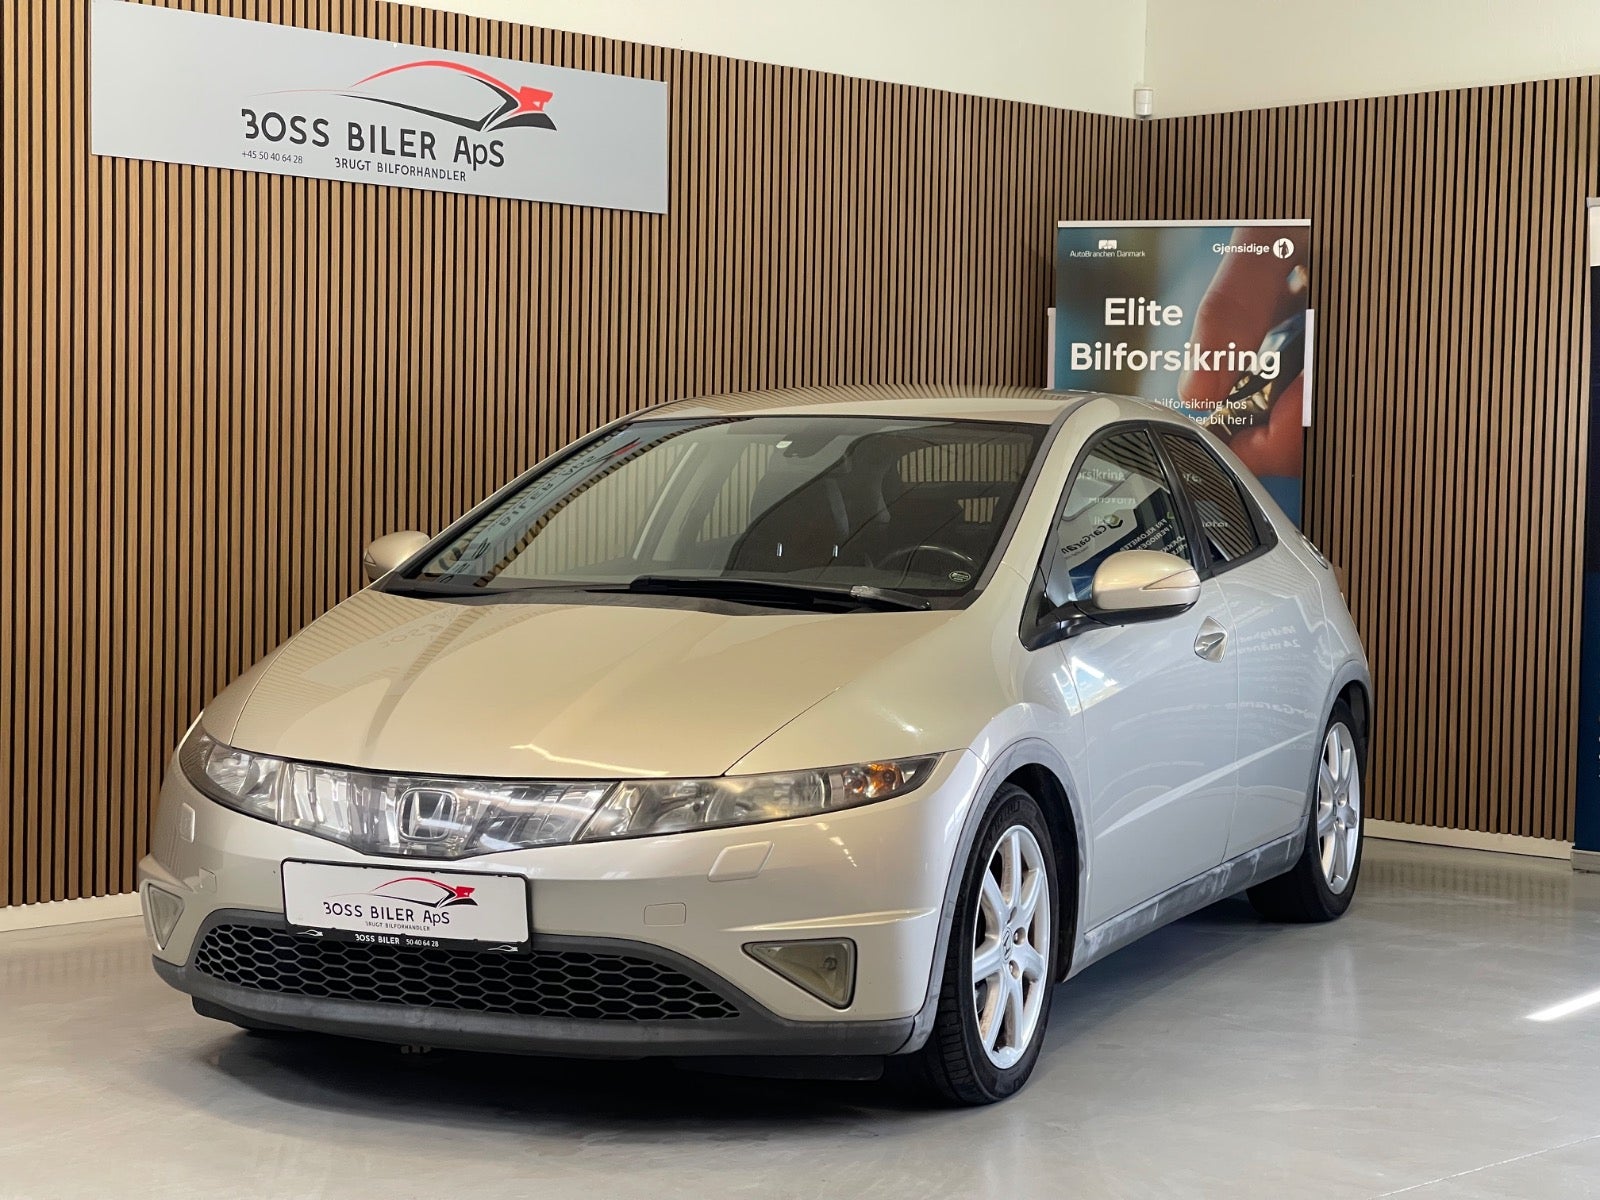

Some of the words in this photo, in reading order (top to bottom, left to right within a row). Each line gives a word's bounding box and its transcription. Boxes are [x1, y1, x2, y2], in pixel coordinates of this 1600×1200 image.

[347, 121, 437, 161] BILER
[453, 135, 506, 171] ApS
[242, 150, 257, 159] +45
[259, 151, 269, 160] 50
[270, 152, 280, 161] 40
[281, 153, 292, 163] 64
[293, 155, 303, 164] 28
[376, 162, 466, 182] BILFORHANDLER
[1069, 250, 1115, 258] AutoBranchen
[1116, 250, 1146, 258] Danmark
[1212, 243, 1270, 256] Gjensidige
[1104, 296, 1184, 327] Elite
[1070, 341, 1281, 380] Bilforsikring
[1226, 398, 1247, 410] hos
[1210, 414, 1225, 425] bil
[1227, 414, 1247, 425] her
[1250, 414, 1254, 425] i
[370, 906, 415, 922] BILER
[422, 910, 450, 927] ApS
[385, 922, 430, 932] BILFORHANDLER
[378, 935, 400, 945] BILER
[405, 938, 414, 946] 50
[422, 939, 430, 947] 64
[431, 940, 439, 948] 28
